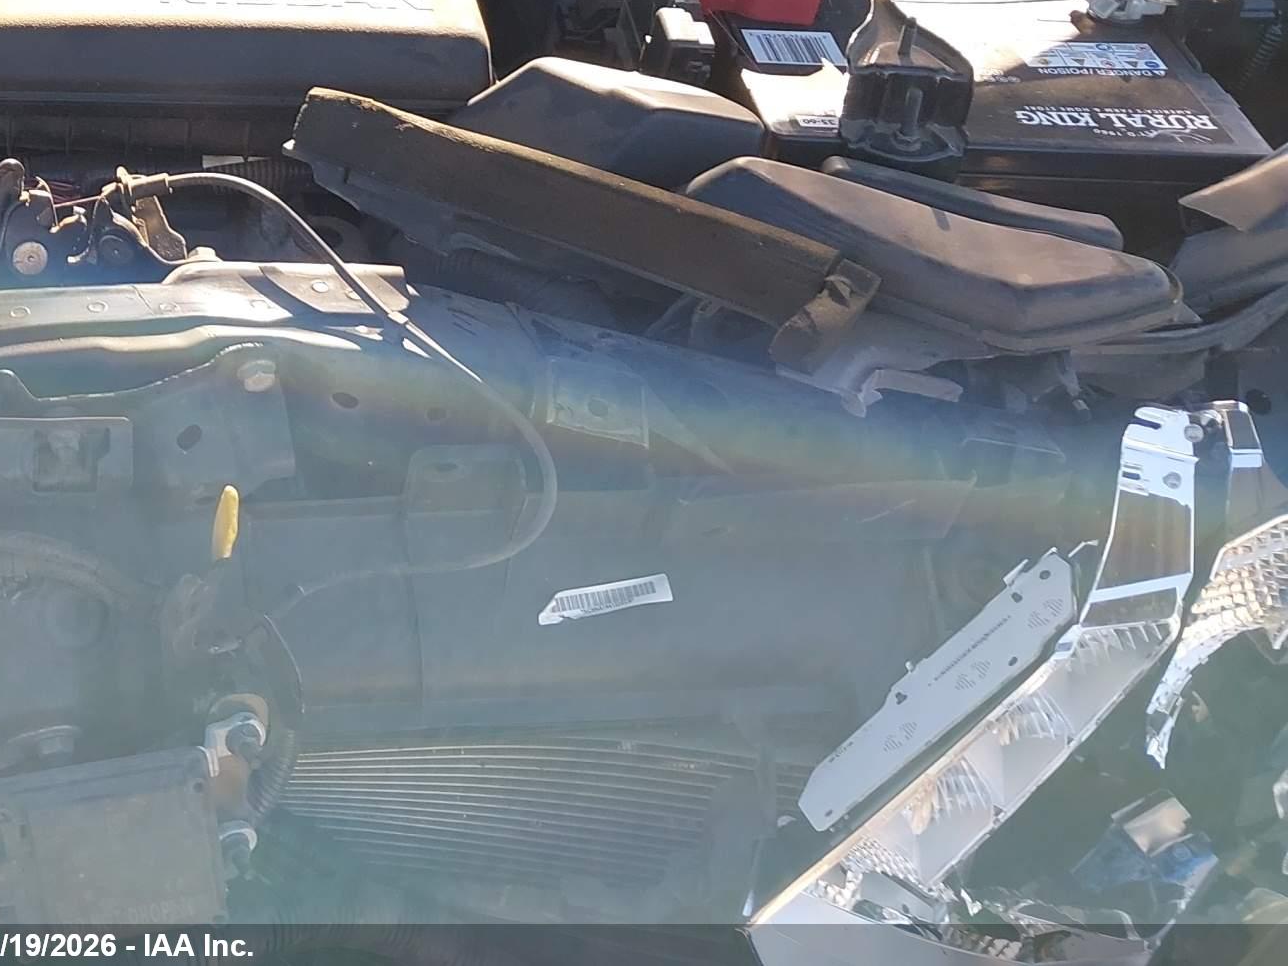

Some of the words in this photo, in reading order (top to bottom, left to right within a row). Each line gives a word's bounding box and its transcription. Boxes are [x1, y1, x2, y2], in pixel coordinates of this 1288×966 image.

[1095, 67, 1153, 77] DANGER
[1014, 110, 1100, 127] KING
[1097, 113, 1219, 130] RURAL
